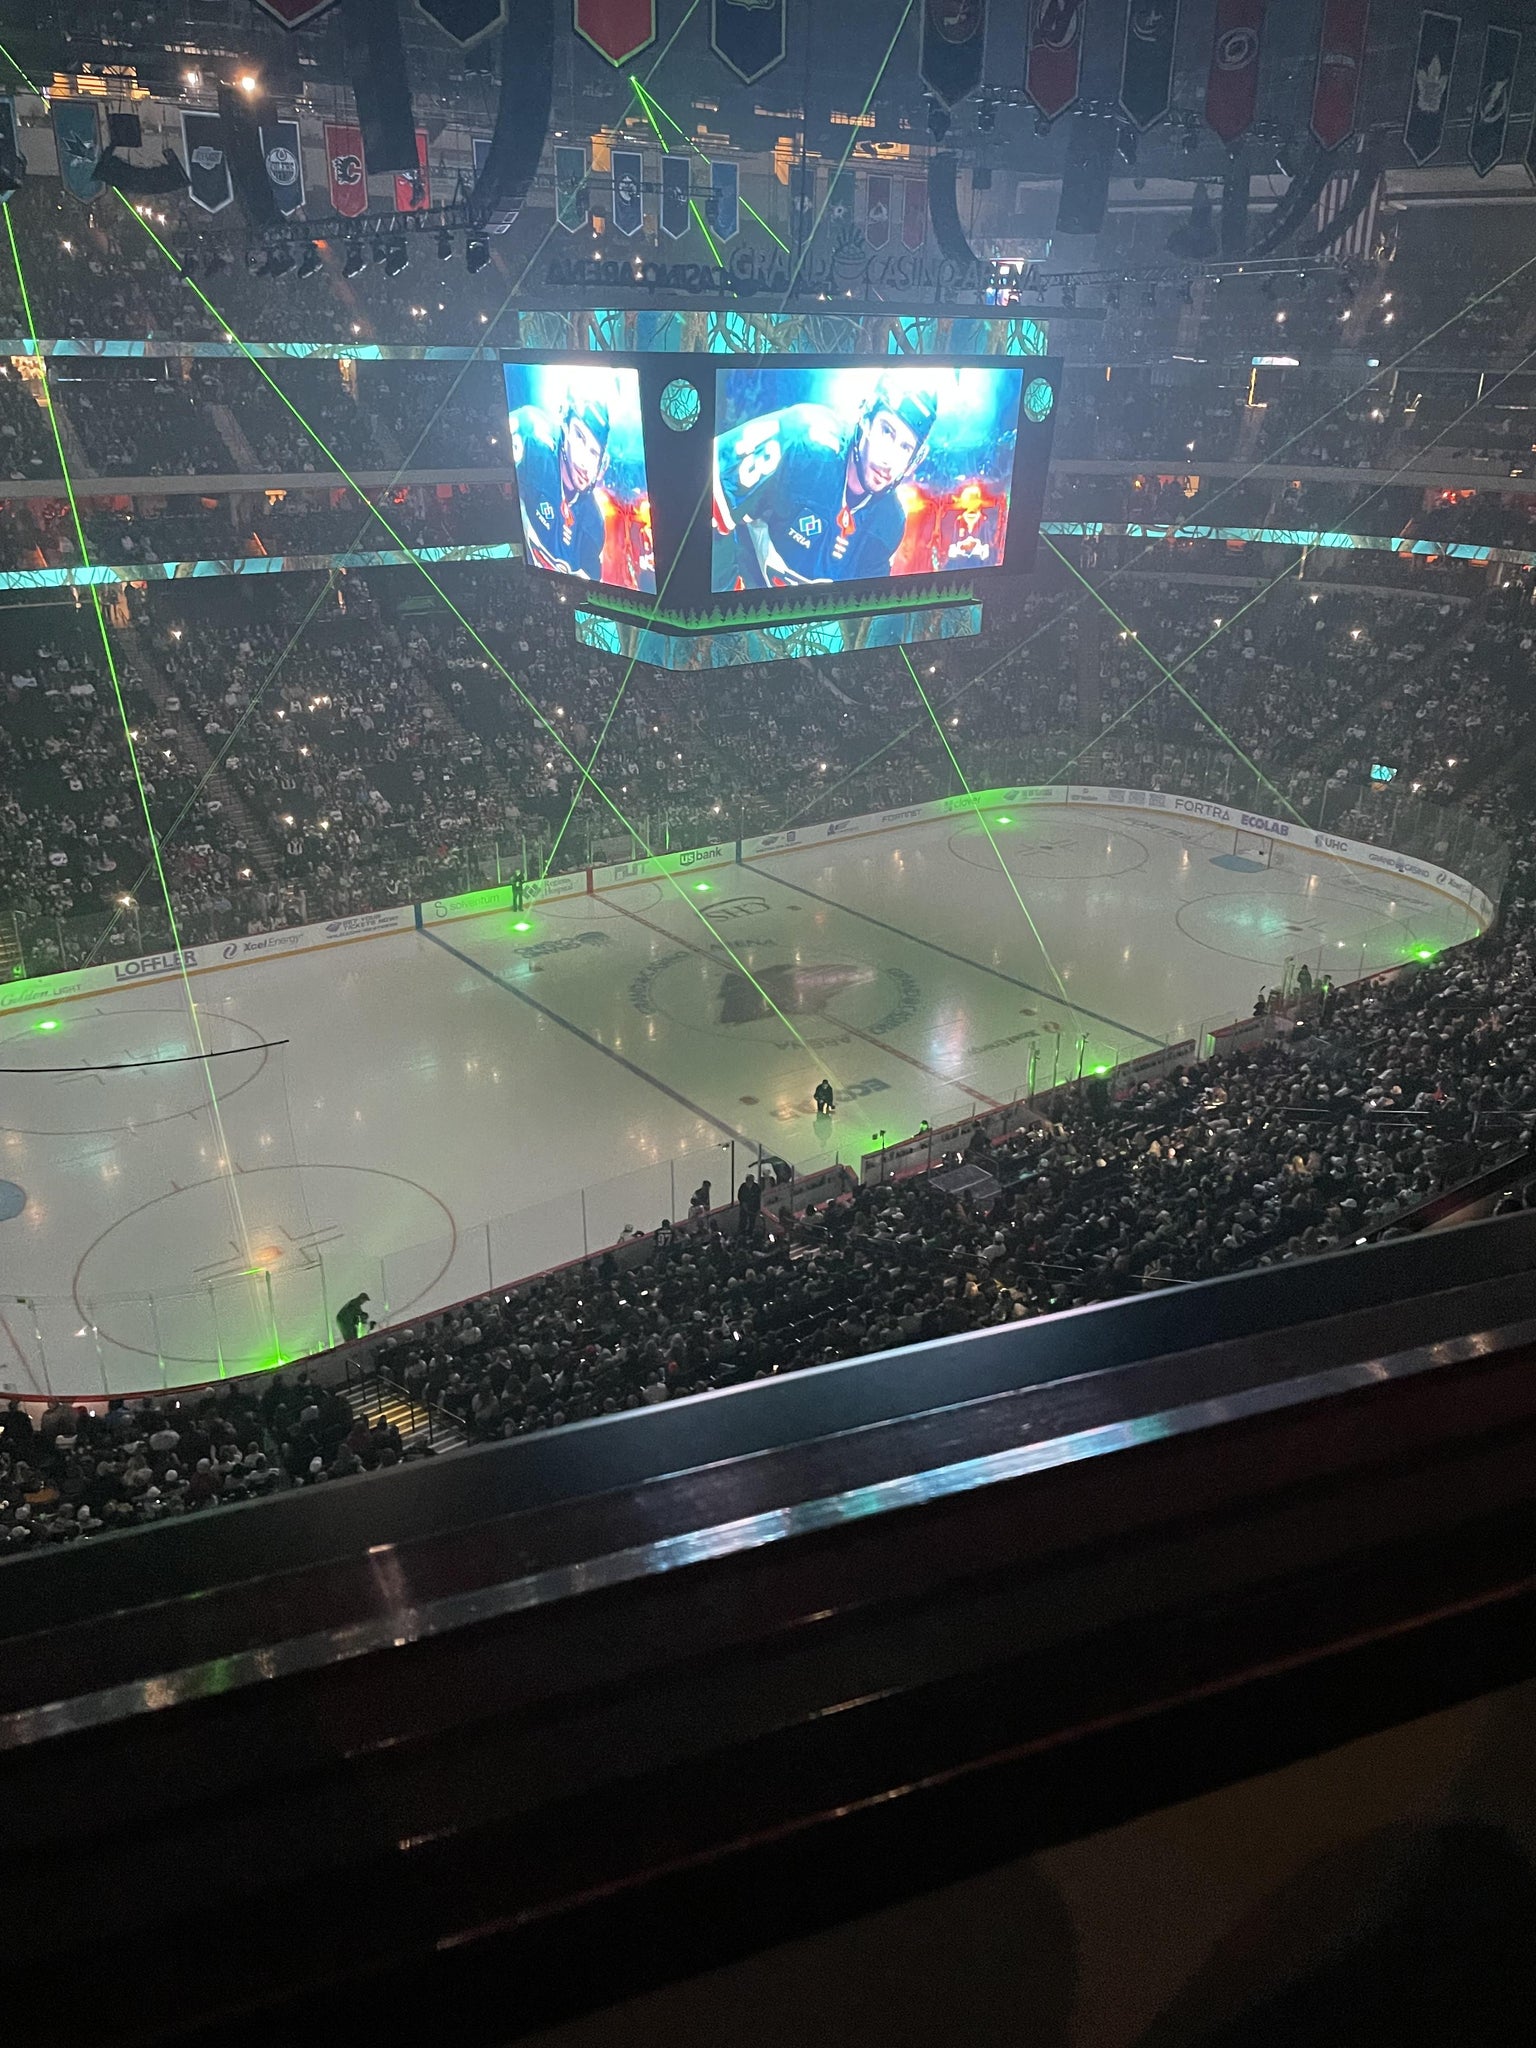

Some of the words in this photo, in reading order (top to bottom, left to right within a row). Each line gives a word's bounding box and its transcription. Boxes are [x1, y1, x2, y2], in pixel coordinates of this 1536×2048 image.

[731, 246, 830, 281] GRAND
[865, 254, 957, 289] CASINO
[788, 527, 811, 549] TRIA
[881, 808, 922, 823] FORTINET
[1174, 798, 1230, 821] FORTRA
[1240, 814, 1289, 836] ECOLAB
[1325, 837, 1349, 852] UHC
[695, 847, 722, 861] bank
[449, 893, 500, 911] solventum
[243, 941, 268, 952] Xcel
[268, 934, 299, 946] Energy
[114, 951, 197, 978] LOFFLER
[657, 1234, 672, 1247] 97
